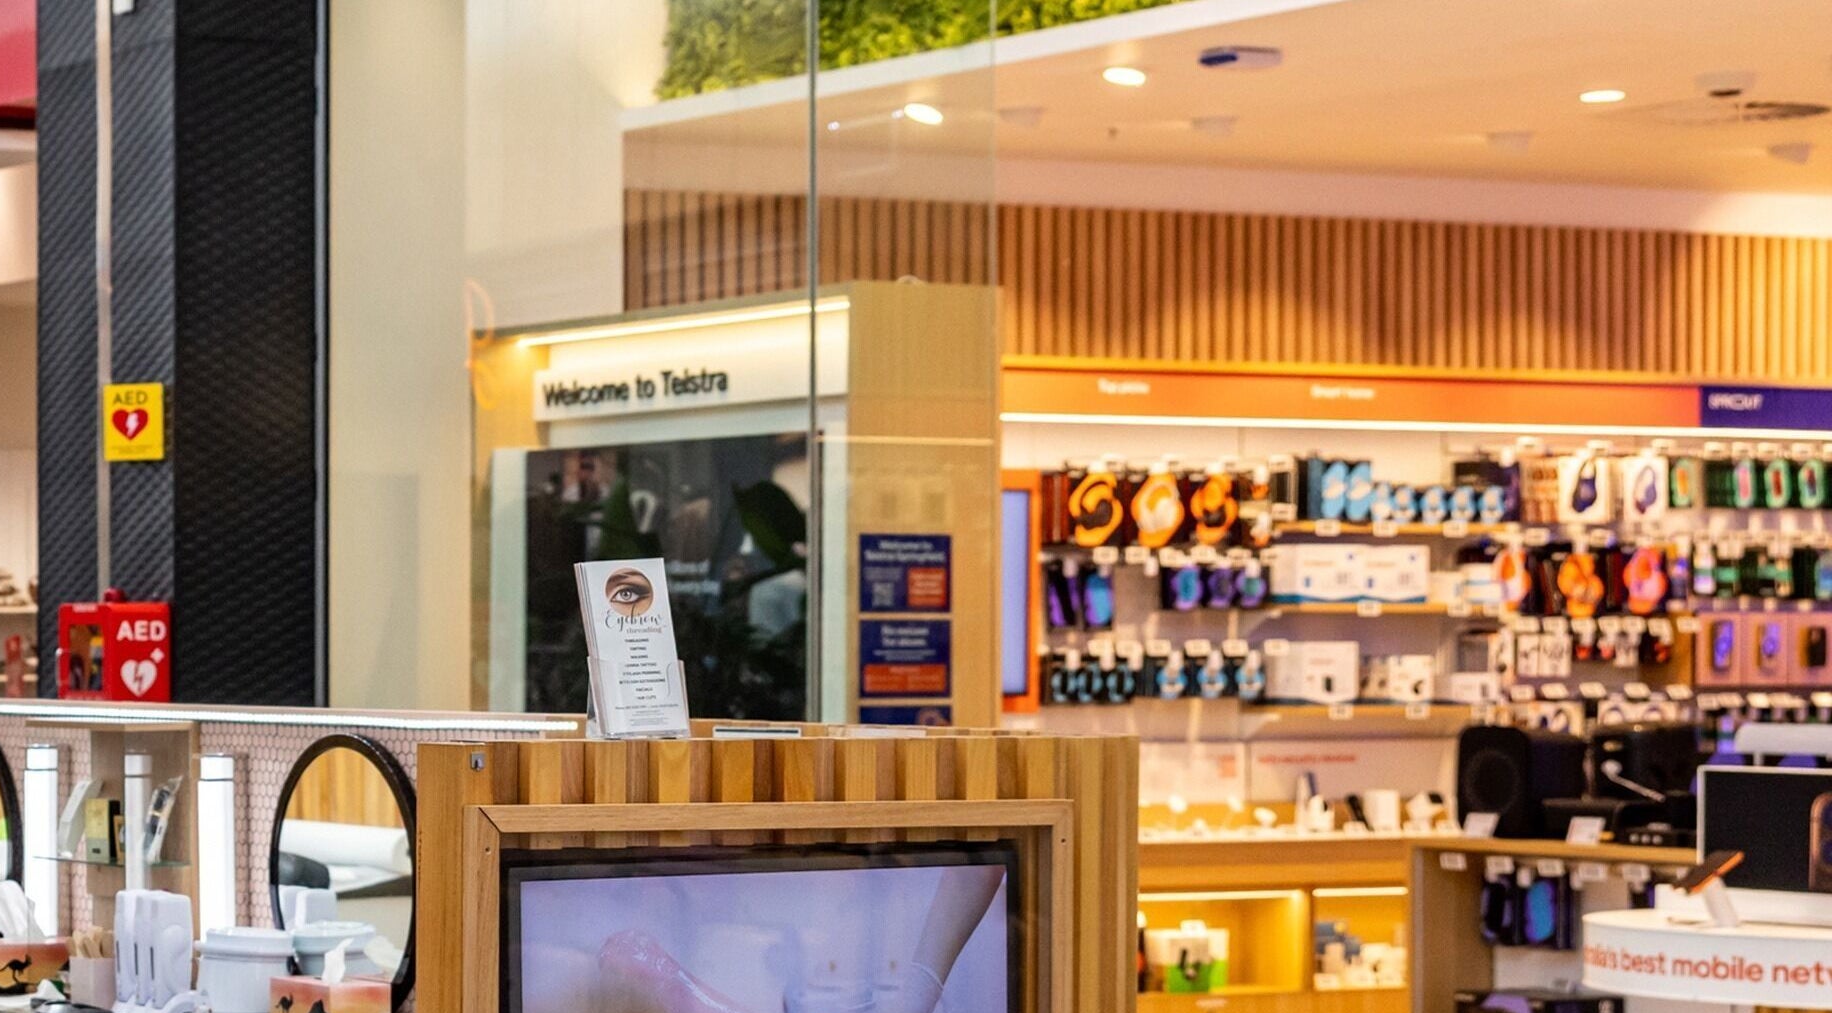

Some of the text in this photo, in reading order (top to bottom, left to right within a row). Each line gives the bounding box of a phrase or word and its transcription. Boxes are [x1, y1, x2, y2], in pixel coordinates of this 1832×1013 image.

[111, 389, 149, 406] AED
[543, 367, 729, 407] Welcome to Telstra
[116, 620, 168, 642] AED
[605, 606, 663, 632] Eyebrow
[1621, 948, 1666, 975] best
[1672, 955, 1764, 982] mobile
[1771, 960, 1832, 985] net
